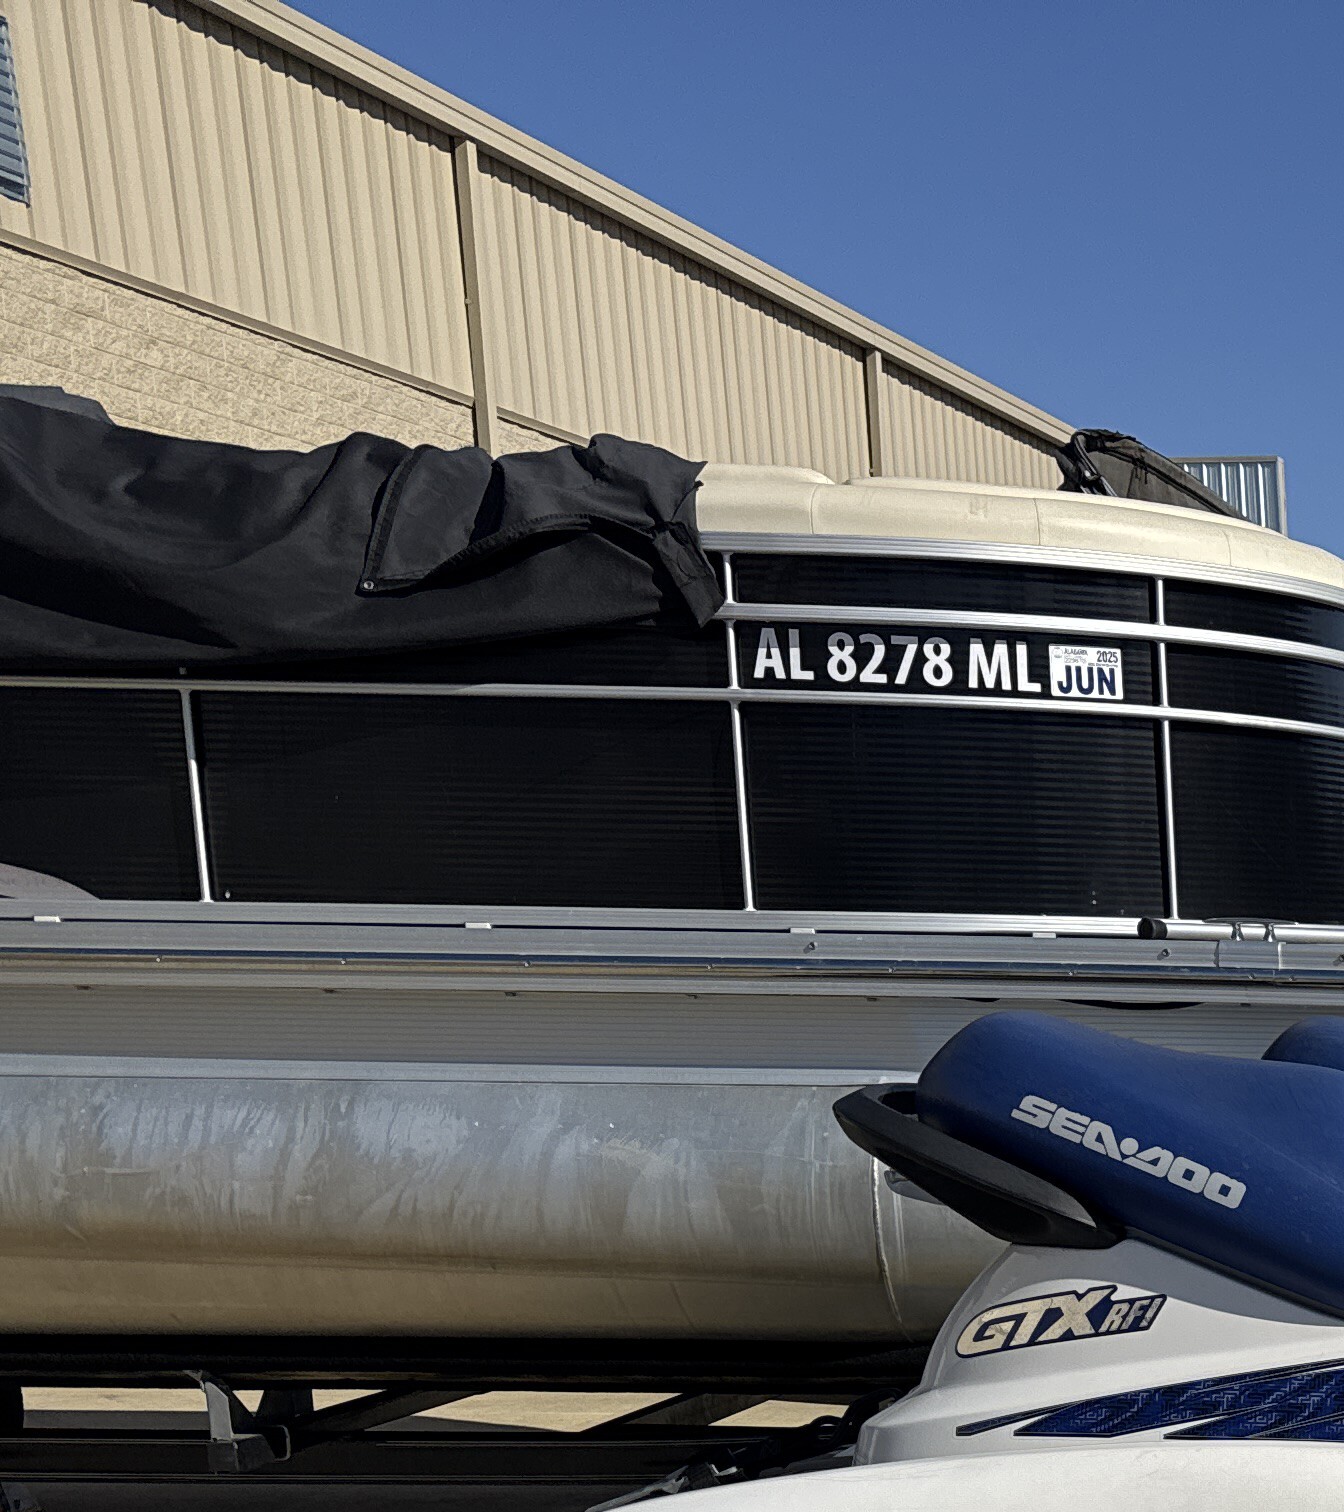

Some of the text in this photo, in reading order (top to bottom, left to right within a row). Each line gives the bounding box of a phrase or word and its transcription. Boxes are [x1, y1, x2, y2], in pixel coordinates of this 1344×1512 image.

[753, 627, 1042, 693] AL 8278 ML
[1057, 664, 1117, 697] JUN
[1096, 650, 1119, 664] 2025
[957, 1285, 1118, 1358] GTX
